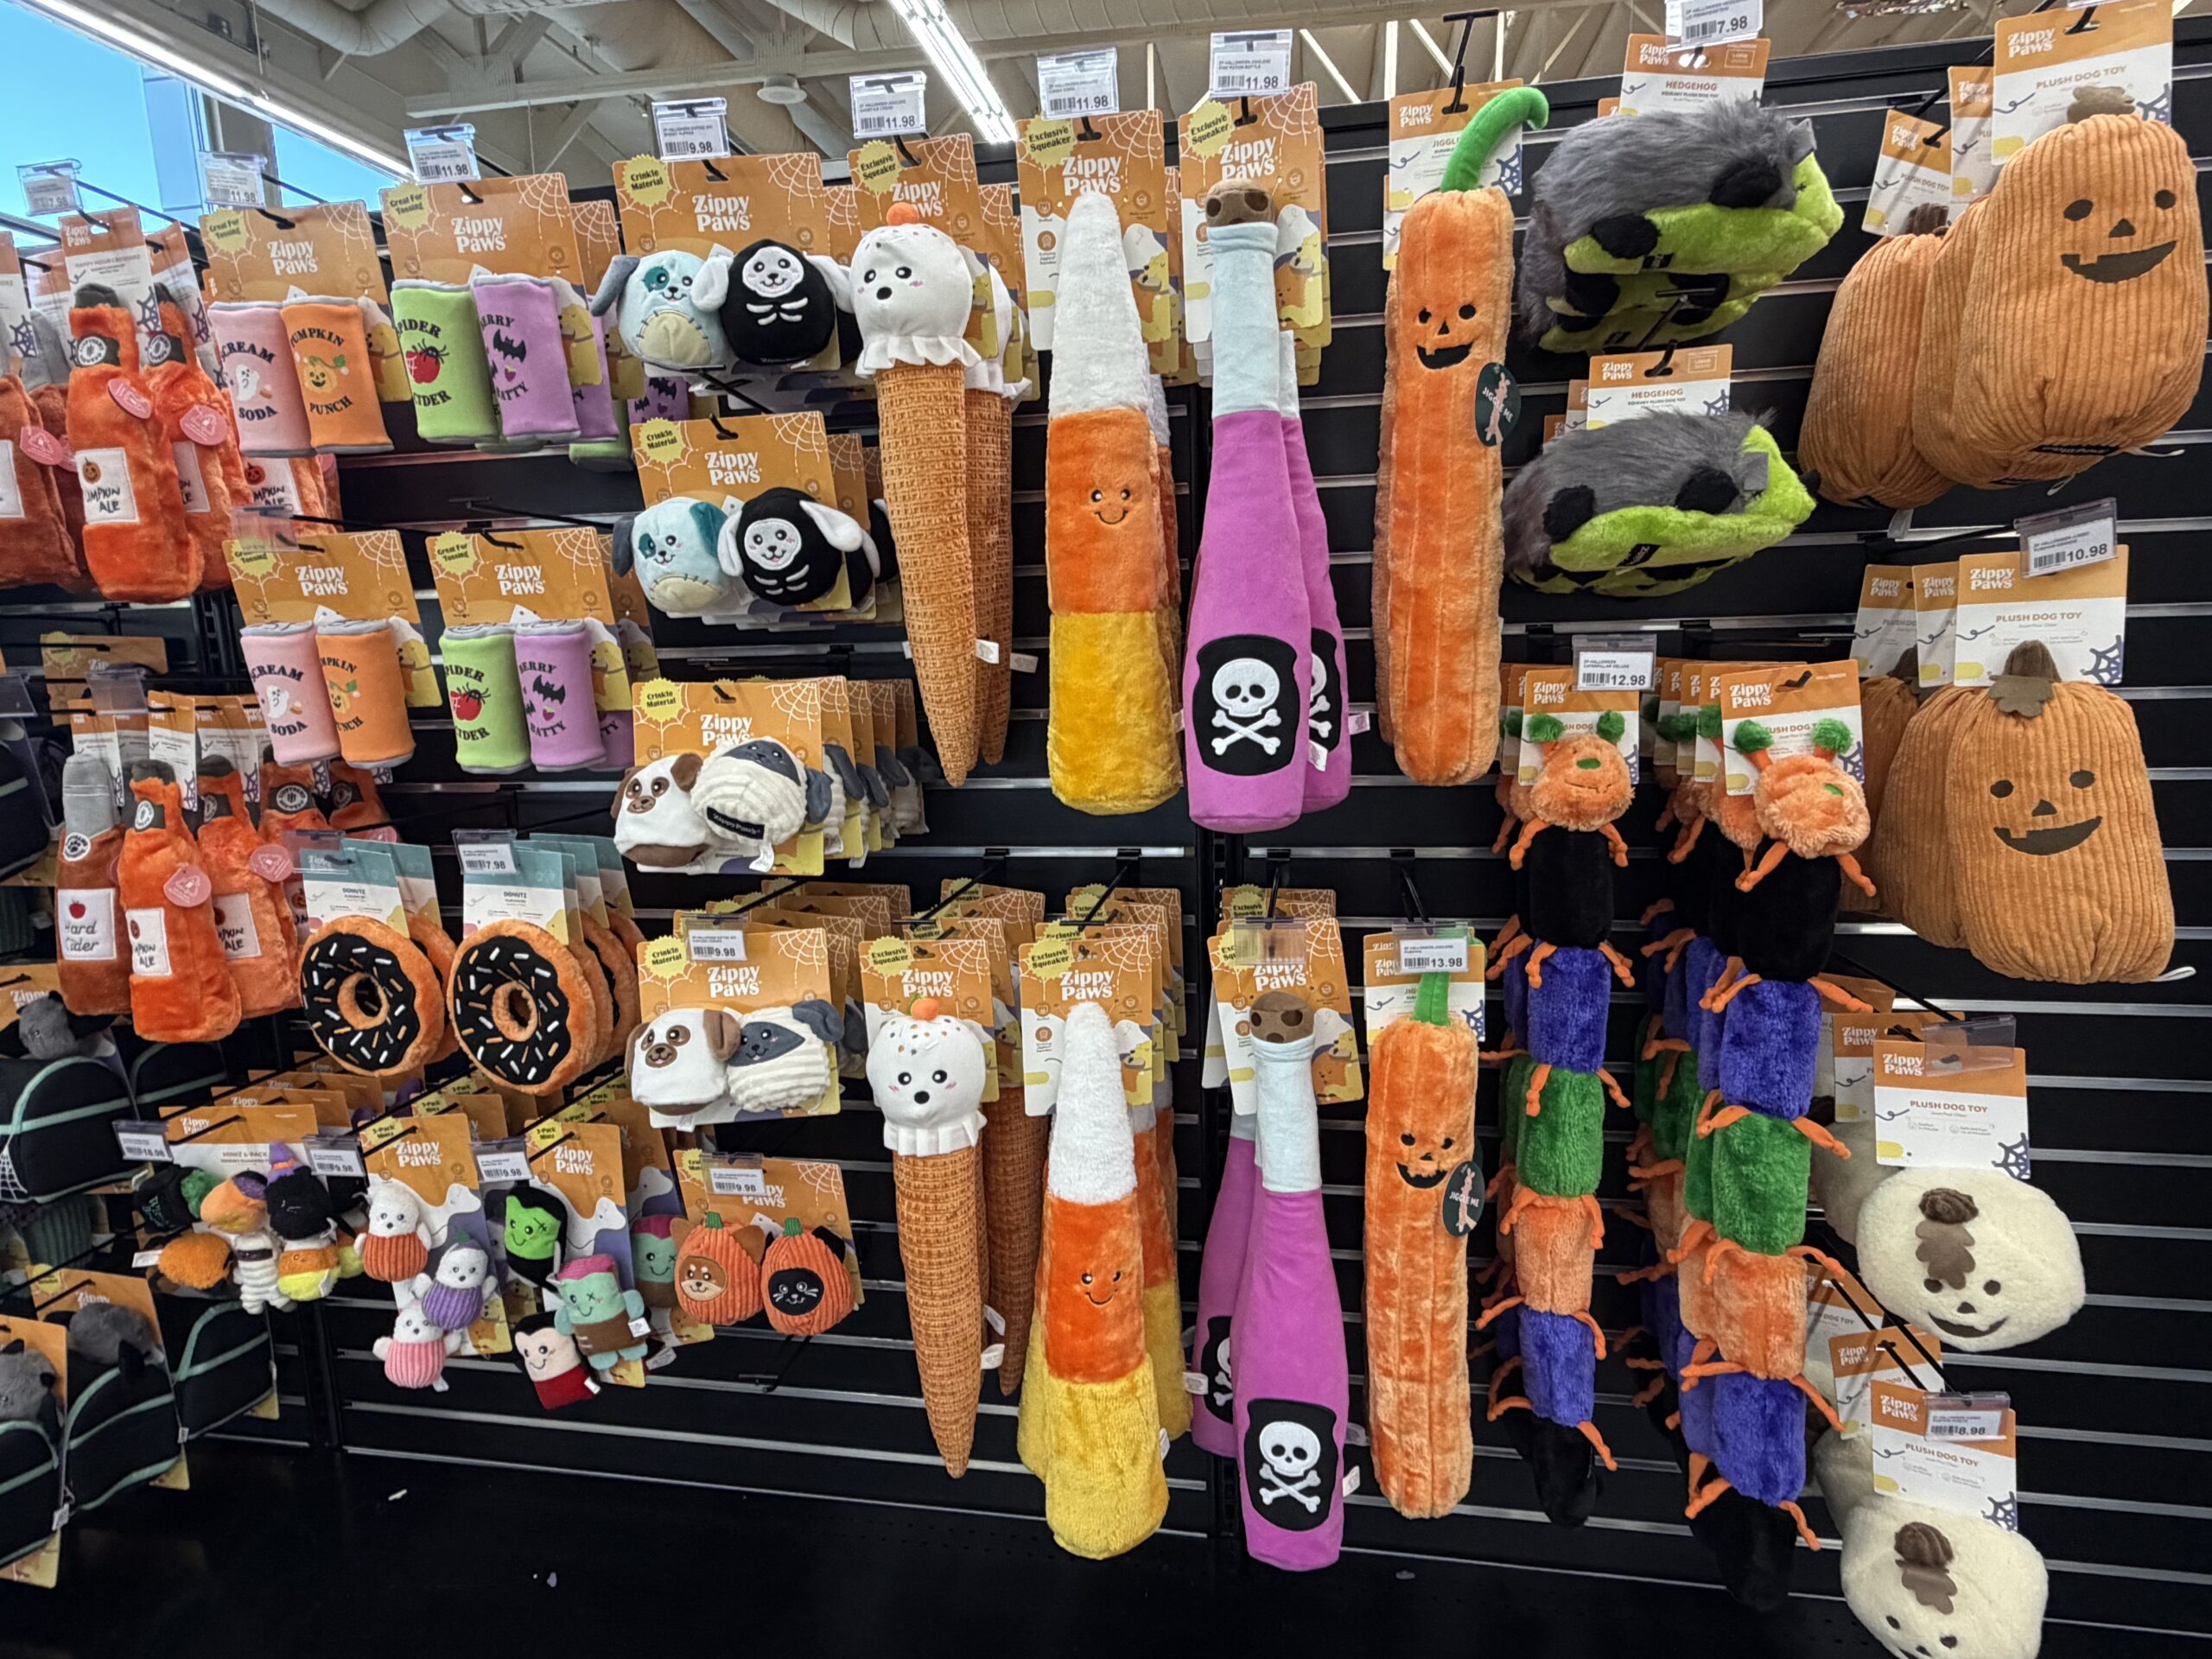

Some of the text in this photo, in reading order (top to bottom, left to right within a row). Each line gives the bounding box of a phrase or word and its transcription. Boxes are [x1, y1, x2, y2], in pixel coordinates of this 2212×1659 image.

[1717, 16, 1748, 35] 7.98
[2008, 28, 2054, 50] Zippy
[2009, 40, 2053, 58] Paws
[1640, 52, 1669, 67] Paws
[1244, 76, 1279, 89] 11.98
[2037, 65, 2126, 89] PLUSH DOG TOY
[1666, 80, 1717, 91] HEDGEHOG
[1075, 94, 1109, 109] 11.98
[1400, 105, 1433, 121] Zippy
[1400, 114, 1433, 127] Paws
[884, 115, 916, 129] 11.98
[1190, 114, 1228, 135] Exclusive
[1028, 125, 1069, 143] Exclusive
[1192, 123, 1232, 146] Squeaker
[689, 141, 714, 154] 9.98
[1029, 135, 1071, 153] Squeaker
[1219, 136, 1276, 164] Zippy
[441, 164, 469, 176] 11.98
[860, 154, 893, 171] Exclusive
[1061, 154, 1122, 178] Zippy
[630, 168, 659, 181] Crinkle
[862, 162, 897, 181] Squeaker
[1222, 159, 1275, 182] Paws
[631, 176, 664, 191] Material
[1064, 173, 1121, 197] Paws
[1922, 178, 1936, 188] DOG
[230, 190, 257, 202] 11.98
[892, 181, 941, 202] Zippy
[692, 194, 749, 216] Zippy
[451, 217, 503, 238] Zippy
[696, 212, 751, 232] Paws
[267, 239, 314, 261] Zippy
[455, 233, 505, 253] Paws
[272, 256, 317, 275] Paws
[397, 319, 442, 339] PIDER
[1602, 362, 1634, 372] Zippy
[1603, 372, 1633, 381] Paws
[1631, 388, 1683, 399] HEDGEHOG
[238, 405, 277, 421] SODA
[309, 396, 353, 415] PUNCH
[1503, 408, 1514, 423] ME
[646, 429, 673, 442] Crinkle
[647, 436, 678, 450] Material
[704, 451, 759, 472] Zippy
[710, 467, 761, 486] Paws
[99, 500, 121, 513] ALE
[2066, 543, 2108, 563] 10.98
[295, 565, 345, 584] Zippy
[494, 563, 543, 583] Zippy
[1970, 567, 2015, 584] Zippy
[302, 580, 348, 596] Paws
[500, 579, 546, 596] Paws
[1872, 576, 1902, 589] Zippy
[1923, 576, 1955, 591] Zippy
[1971, 577, 2014, 591] Paws
[1871, 586, 1899, 597] Paws
[1924, 586, 1955, 598] Paws
[1996, 611, 2082, 623] PLUSH DOG TOY
[444, 664, 485, 683] PIDER
[1611, 674, 1646, 686] 12.98
[645, 690, 673, 701] Crinkle
[1533, 682, 1567, 695] Zippy
[1730, 683, 1771, 698] Zippy
[646, 696, 677, 709] Material
[1534, 694, 1566, 704] Paws
[1732, 694, 1771, 709] Paws
[270, 721, 308, 736] SODA
[700, 713, 753, 734] Zippy
[1789, 723, 1810, 733] DOG
[485, 860, 506, 871] 7.98
[225, 939, 245, 950] ALE
[715, 947, 736, 957] 9.98
[652, 946, 679, 959] Crinkle
[652, 954, 683, 966] Material
[870, 947, 908, 959] Exclusive
[872, 954, 910, 966] Squeaker
[1031, 948, 1069, 963] Exclusive
[139, 956, 156, 968] ALE
[1032, 955, 1071, 969] Squeaker
[1431, 957, 1463, 968] 13.98
[707, 965, 760, 983] Zippy
[900, 969, 955, 988] Zippy
[1059, 969, 1115, 988] Zippy
[1255, 971, 1306, 992] Paws
[709, 980, 761, 998] Paws
[903, 984, 954, 998] Paws
[1061, 983, 1114, 1001] Paws
[1841, 1027, 1878, 1039] Zippy
[1843, 1035, 1877, 1046] Paws
[1882, 1052, 1924, 1070] Zippy
[1884, 1064, 1923, 1077] Paws
[1910, 1100, 1942, 1109] PLUSH
[1943, 1103, 1966, 1112] DOG
[1967, 1105, 1988, 1114] TOY
[395, 1141, 440, 1160] Zippy
[554, 1146, 594, 1162] Zippy
[334, 1162, 354, 1173] 9.98
[397, 1153, 442, 1167] Paws
[556, 1160, 594, 1175] Paws
[503, 1167, 522, 1177] 9.98
[735, 1184, 756, 1192] 9.98
[1471, 1197, 1480, 1208] ME
[1880, 1395, 1919, 1414] Zippy
[1882, 1406, 1918, 1422] Paws
[1958, 1426, 1986, 1436] 8.98
[1905, 1443, 1980, 1467] PLUSH DOG TOY
